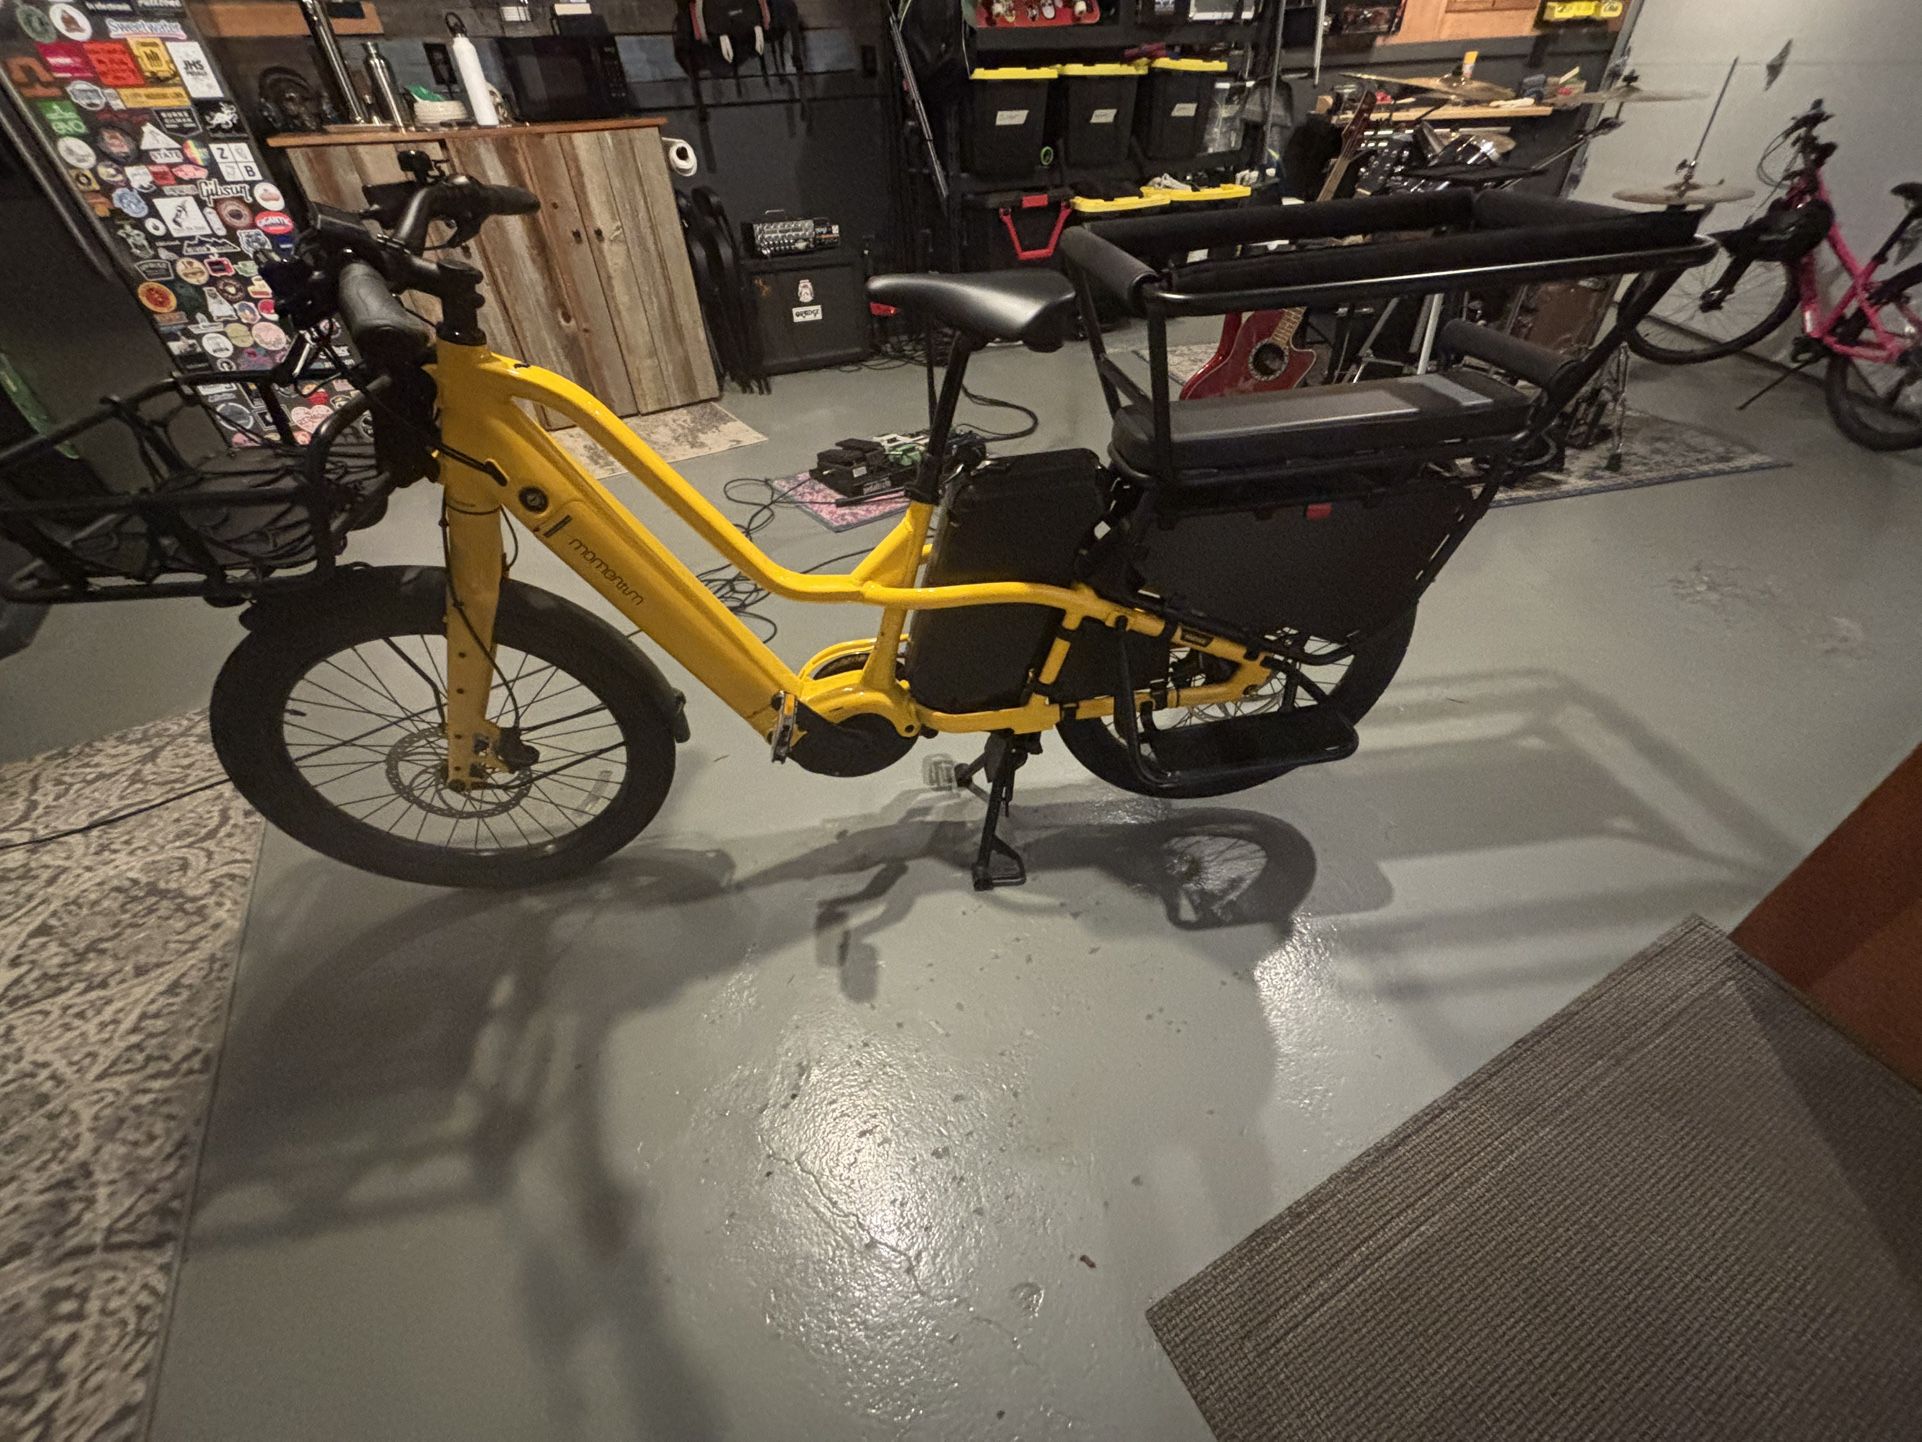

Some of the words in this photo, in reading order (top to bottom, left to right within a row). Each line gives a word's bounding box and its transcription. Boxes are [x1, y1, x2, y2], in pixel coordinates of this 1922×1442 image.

[107, 18, 182, 34] Sweetwater
[183, 60, 204, 70] JHS
[152, 151, 182, 161] STATE
[244, 165, 256, 177] B
[200, 180, 250, 204] Gibson
[567, 538, 645, 606] momentum
